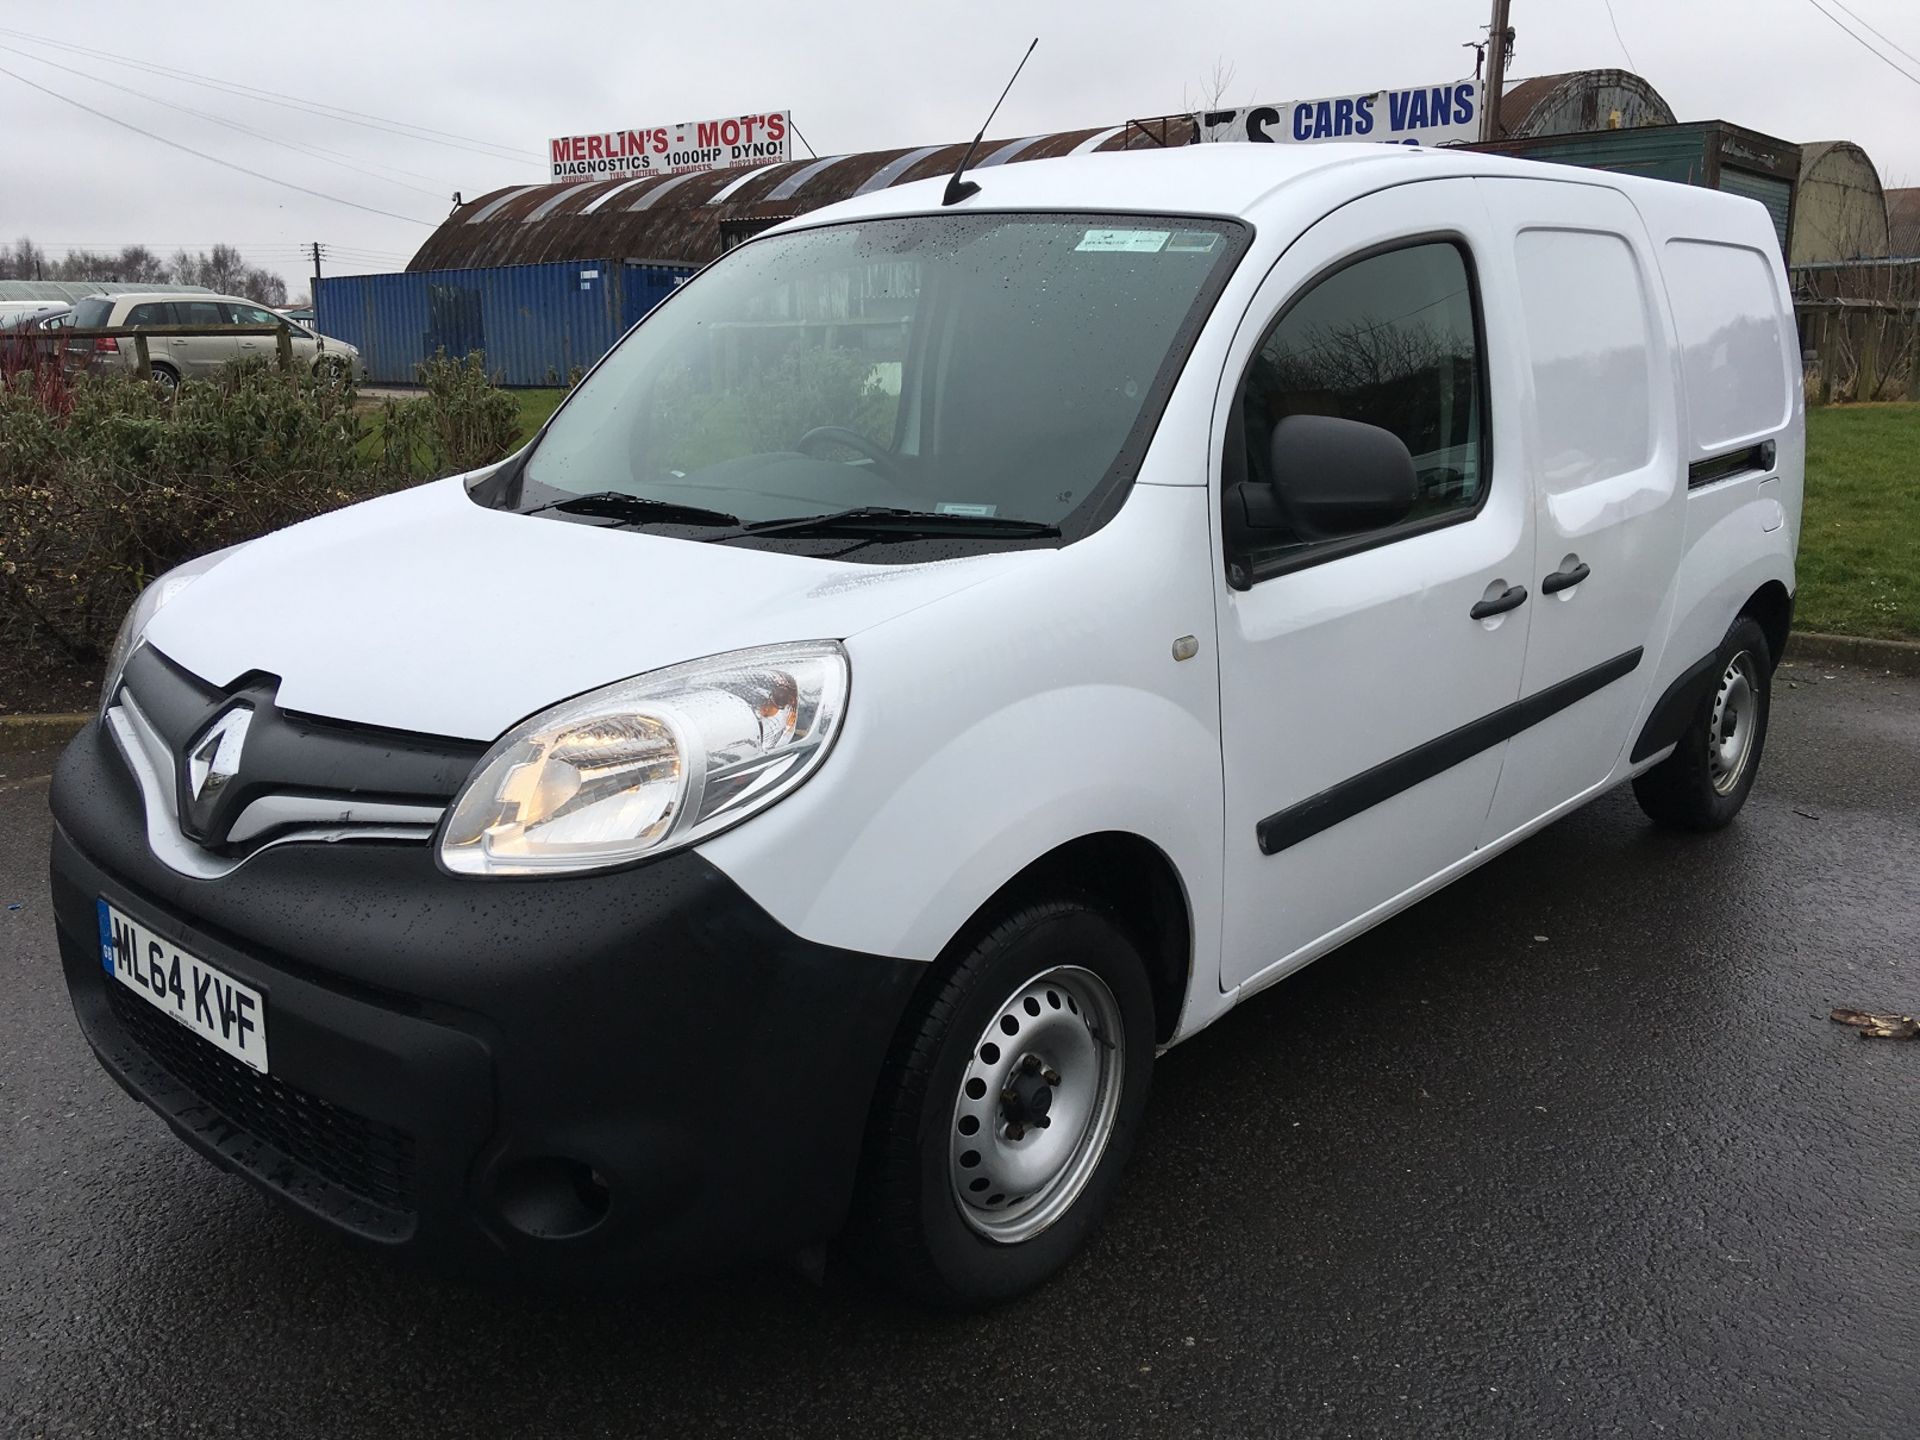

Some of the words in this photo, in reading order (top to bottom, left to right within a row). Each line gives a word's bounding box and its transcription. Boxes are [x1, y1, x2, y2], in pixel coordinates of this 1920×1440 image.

[1292, 96, 1374, 141] CARS
[1388, 84, 1474, 131] VANS
[552, 128, 669, 162] MERLIN'S
[697, 113, 785, 148] MOT'S
[554, 155, 650, 176] DIAGNOSTICS
[664, 148, 722, 166] 1000HP
[731, 140, 783, 160] DYNO!
[671, 163, 713, 175] EXHAUSTS
[113, 916, 186, 1012] ML64
[192, 965, 255, 1050] KVF
